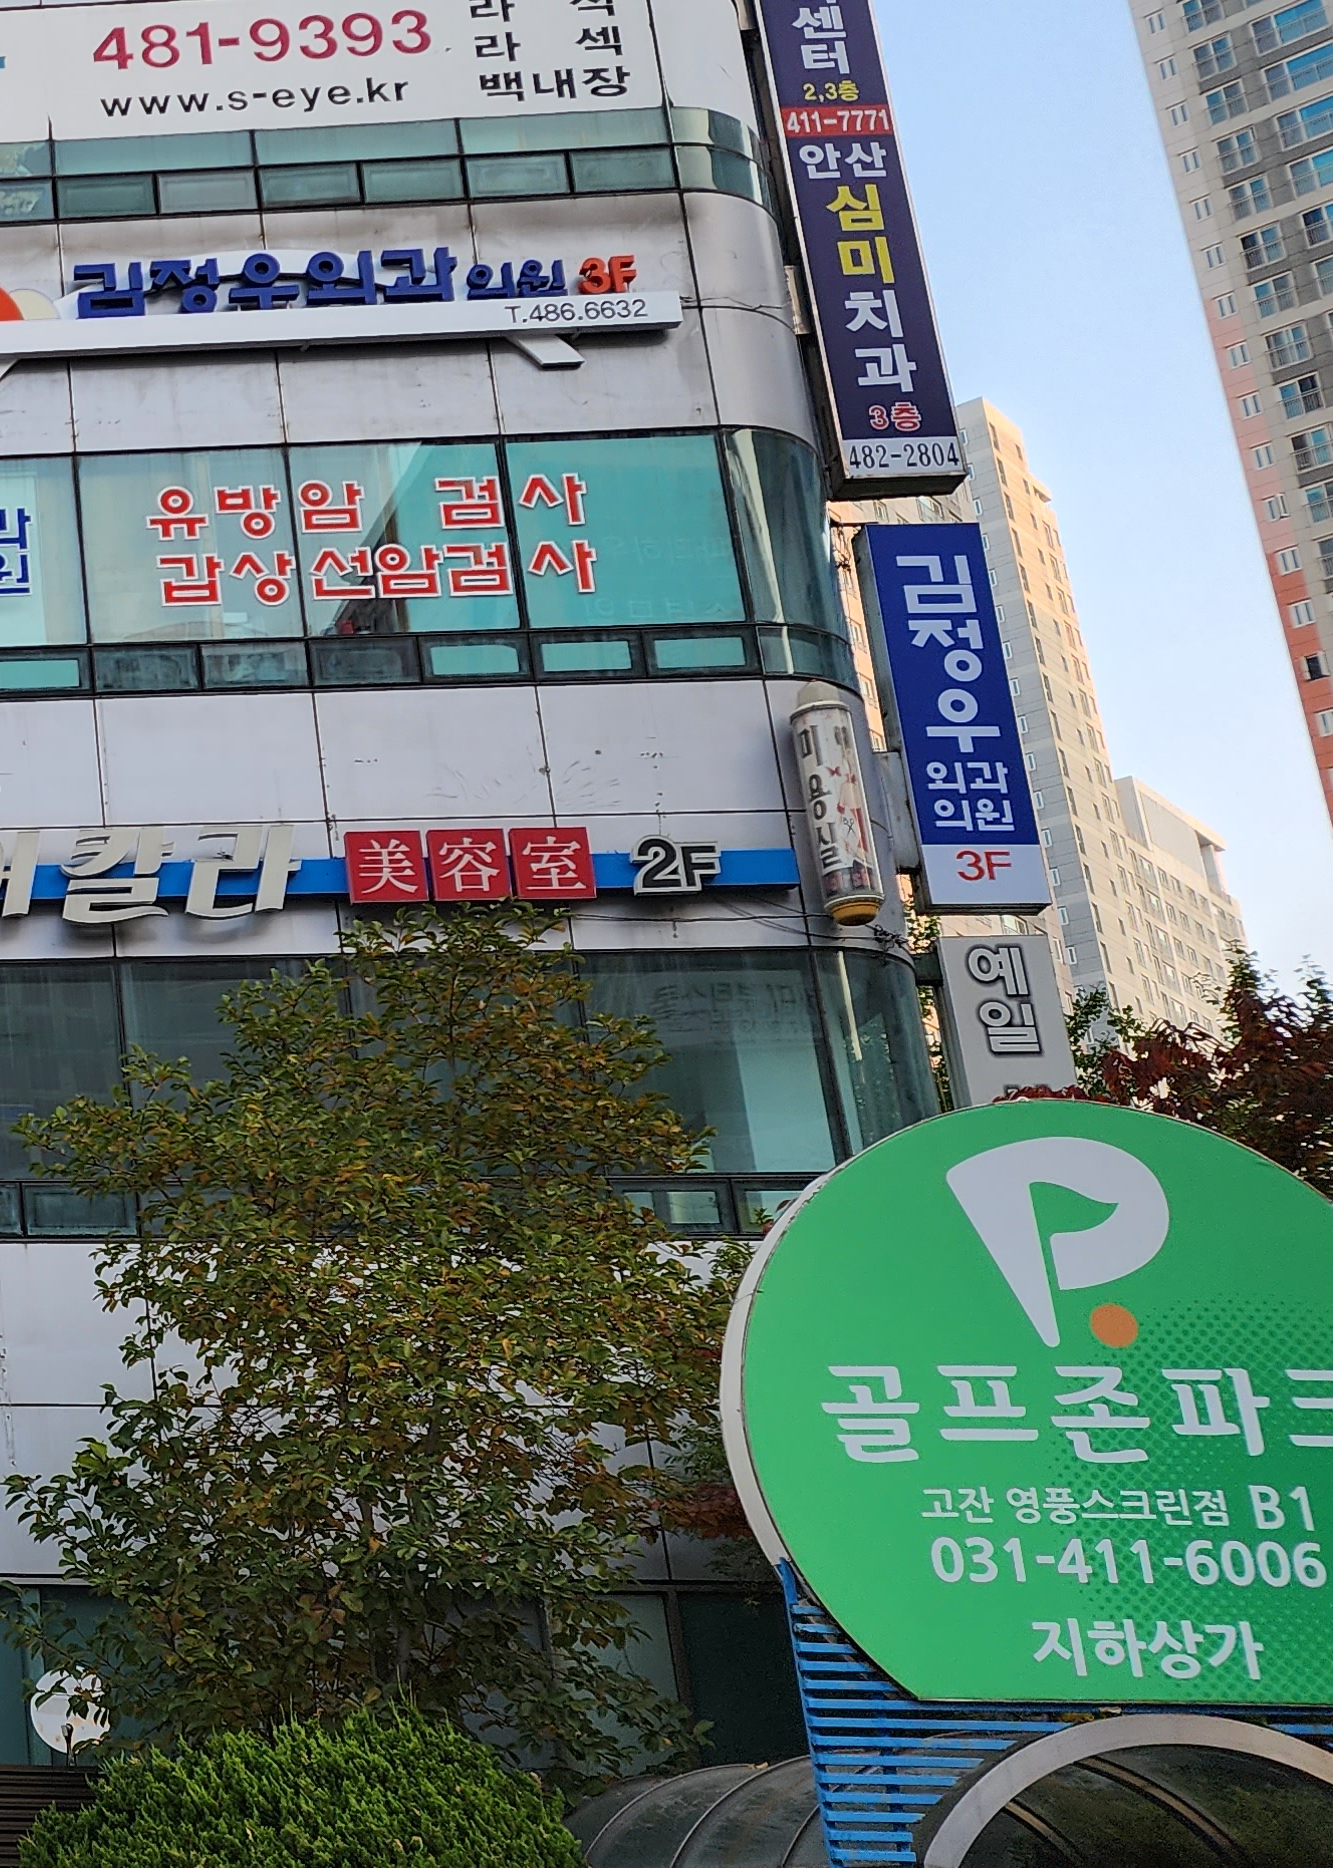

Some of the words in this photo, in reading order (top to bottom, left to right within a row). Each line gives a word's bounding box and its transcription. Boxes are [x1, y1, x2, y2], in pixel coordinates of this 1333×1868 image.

[93, 9, 433, 71] 481-9393
[100, 76, 410, 118] www.s-eye.kr
[479, 65, 631, 102] 백내장
[803, 80, 860, 103] 2,3층
[786, 108, 890, 134] 411-7771
[799, 141, 887, 180] 안산
[72, 246, 458, 320] 김정우외과
[466, 259, 568, 299] 의원
[578, 254, 637, 295] 3F
[826, 183, 917, 393] 심미치과
[504, 299, 649, 325] T.486.6632
[868, 402, 922, 431] 3층
[849, 441, 959, 470] 482-2804
[146, 480, 363, 542] 유방암
[434, 471, 587, 530] 검사
[156, 538, 598, 608] 갑상선암검사
[896, 553, 1001, 754] 김정우
[926, 761, 1009, 794] 외과
[933, 797, 1015, 833] 의원
[358, 836, 585, 896] 美容室
[630, 835, 722, 895] 2F
[956, 849, 1013, 882] 3F
[967, 943, 1042, 1055] 예일
[921, 1488, 995, 1524] 고잔
[1006, 1486, 1230, 1528] 영풍스크린점
[1249, 1485, 1315, 1531] B1
[931, 1537, 1327, 1588] 031-411-6006
[1033, 1619, 1265, 1681] 지하상가
